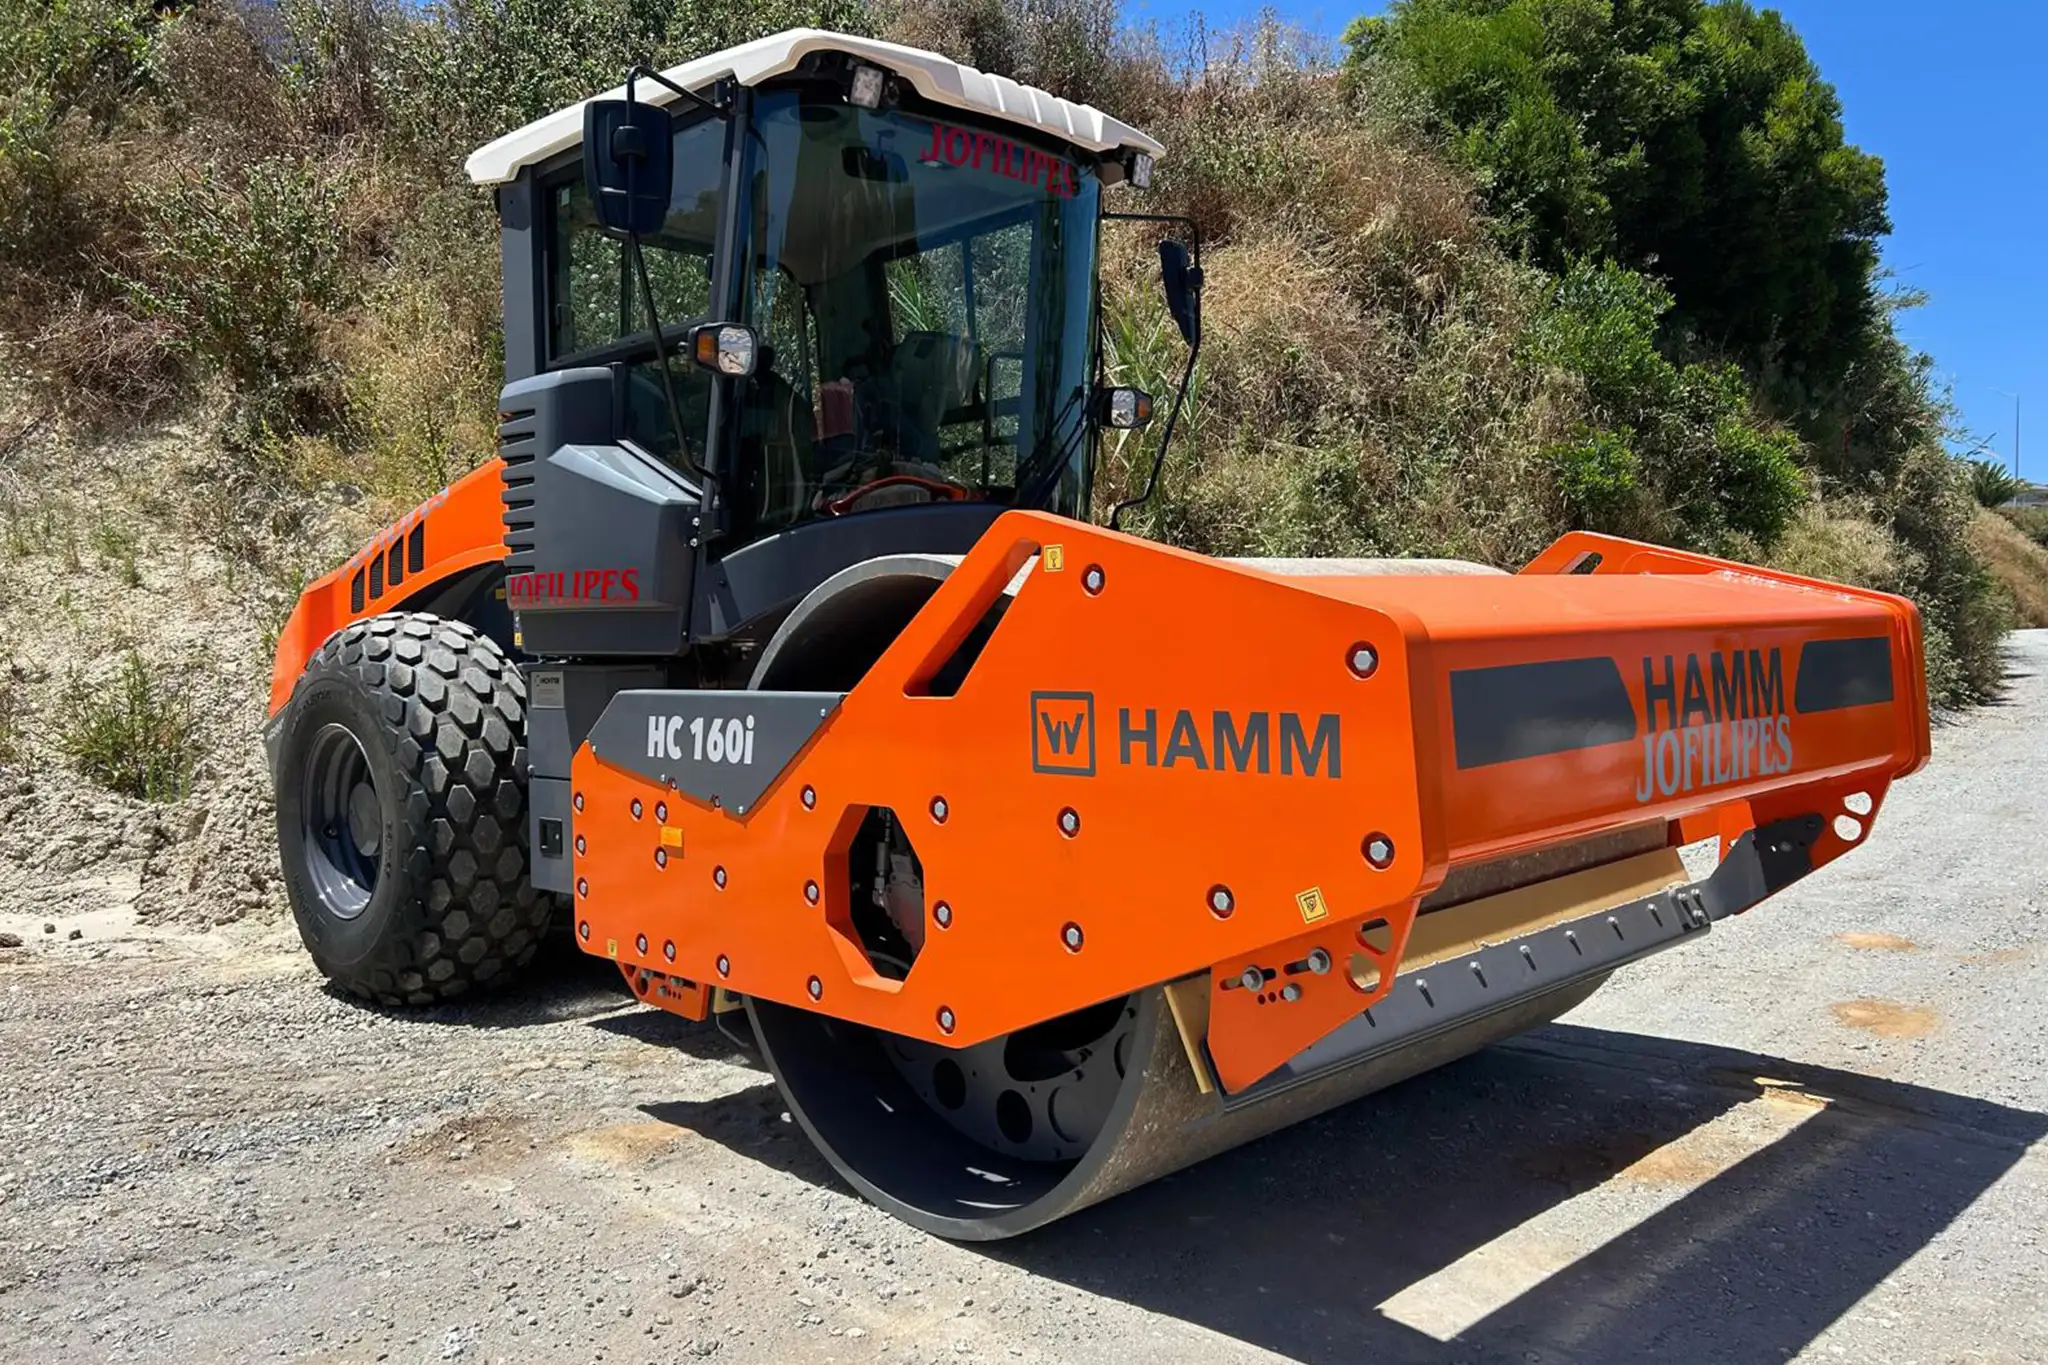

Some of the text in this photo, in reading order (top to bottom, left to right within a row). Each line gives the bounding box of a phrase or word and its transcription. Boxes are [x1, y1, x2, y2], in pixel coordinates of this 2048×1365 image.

[920, 124, 1078, 199] JOFILIPES
[1642, 648, 1785, 735] HAMM
[647, 715, 755, 765] HC 160i
[1118, 708, 1342, 779] HAMM
[1636, 714, 1793, 804] JOFILIPES
